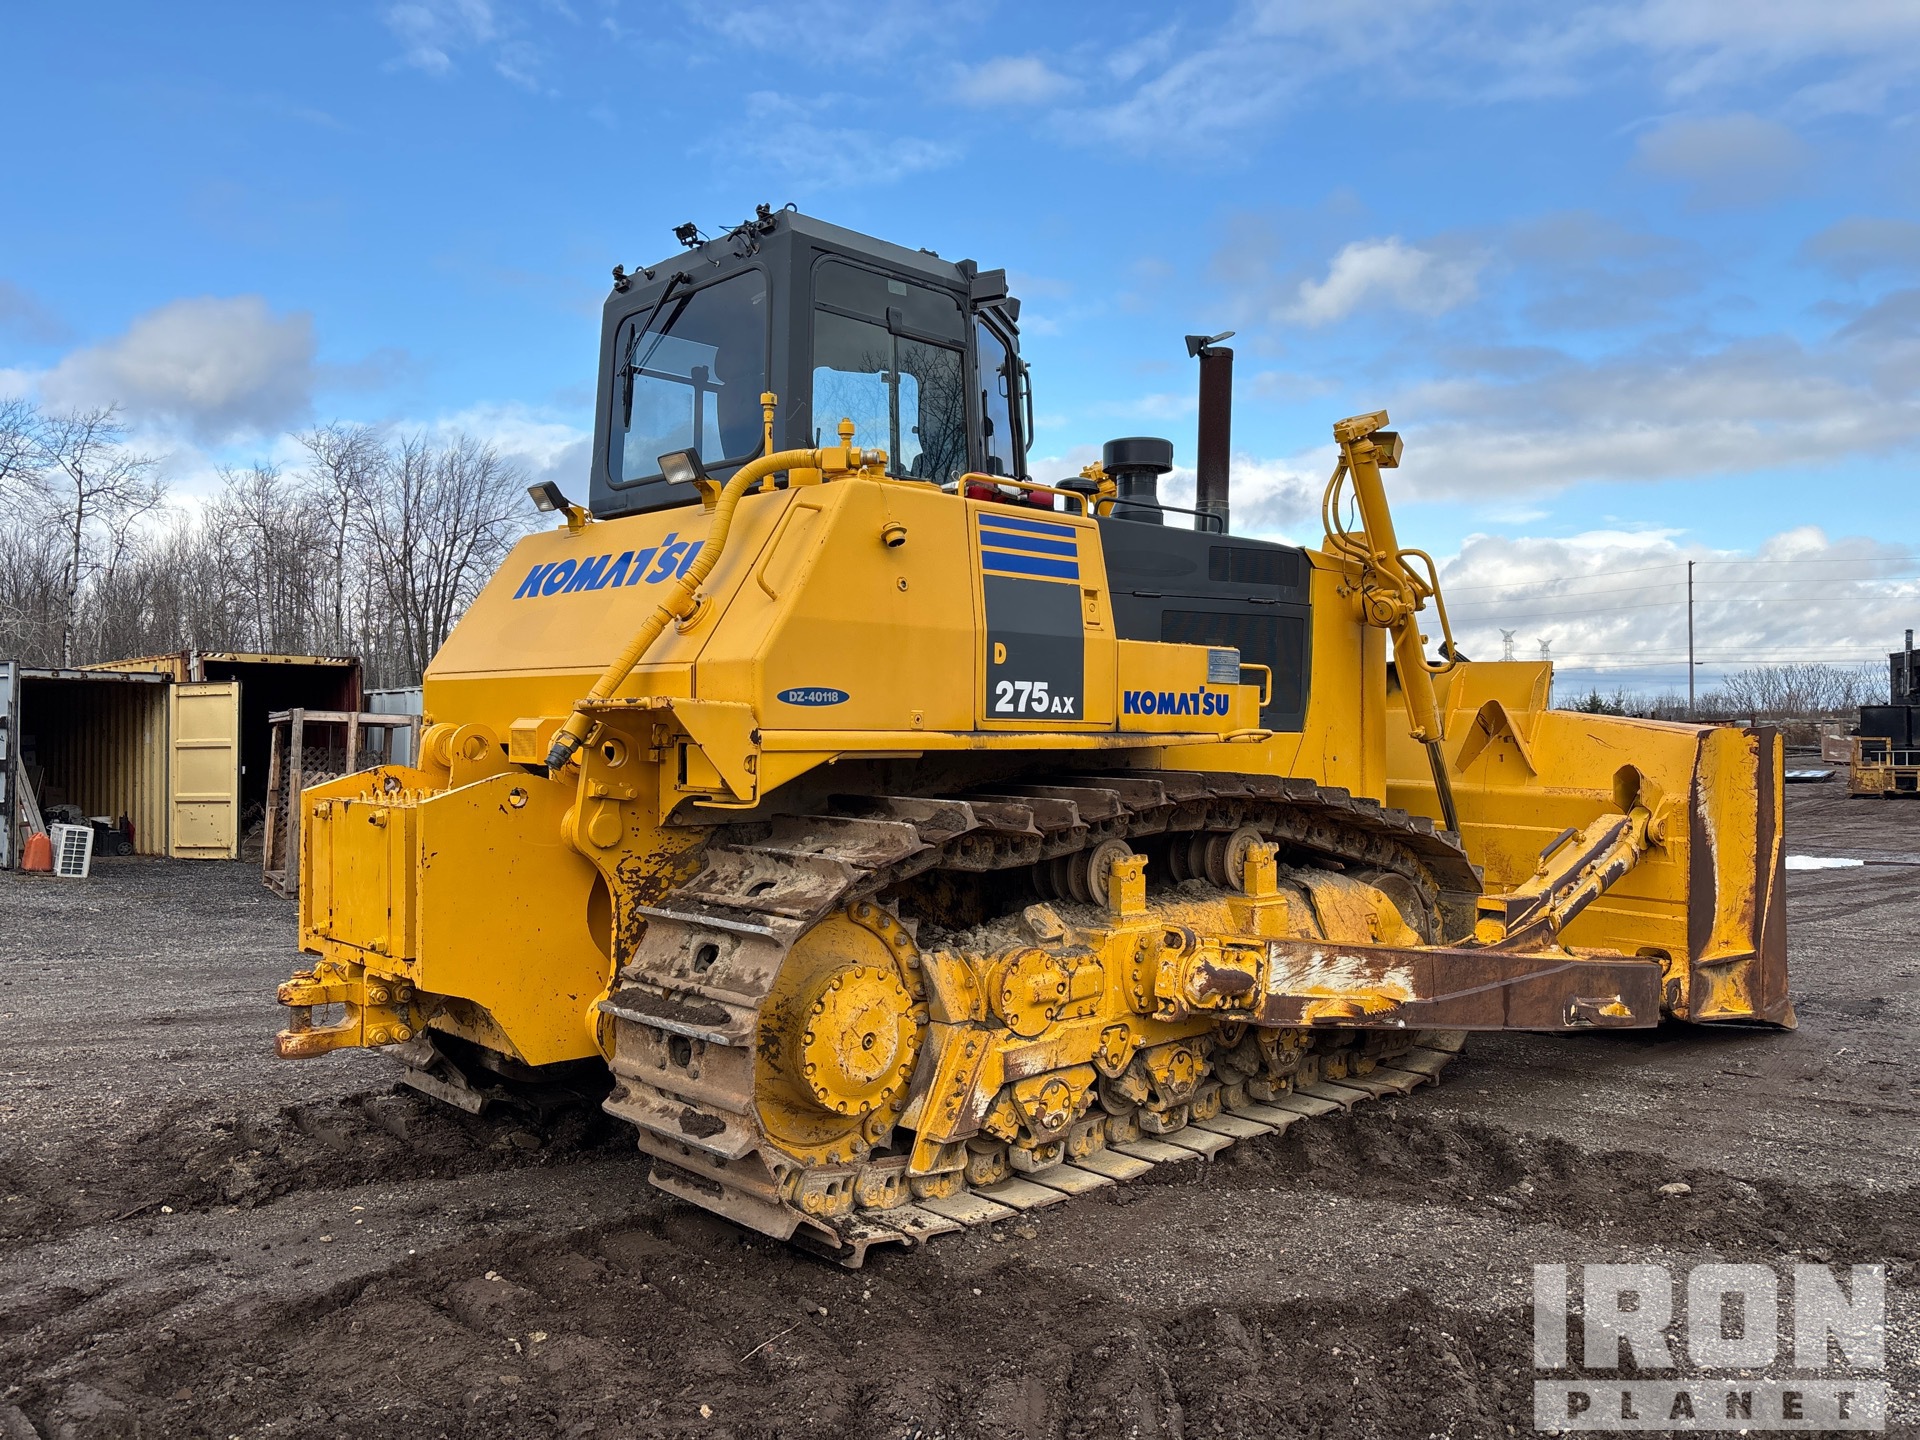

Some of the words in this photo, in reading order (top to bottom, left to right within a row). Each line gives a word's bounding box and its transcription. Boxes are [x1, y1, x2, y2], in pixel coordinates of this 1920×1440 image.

[994, 642, 1007, 665] D
[788, 691, 839, 703] DZ-40118
[1123, 685, 1230, 717] KOMATSU
